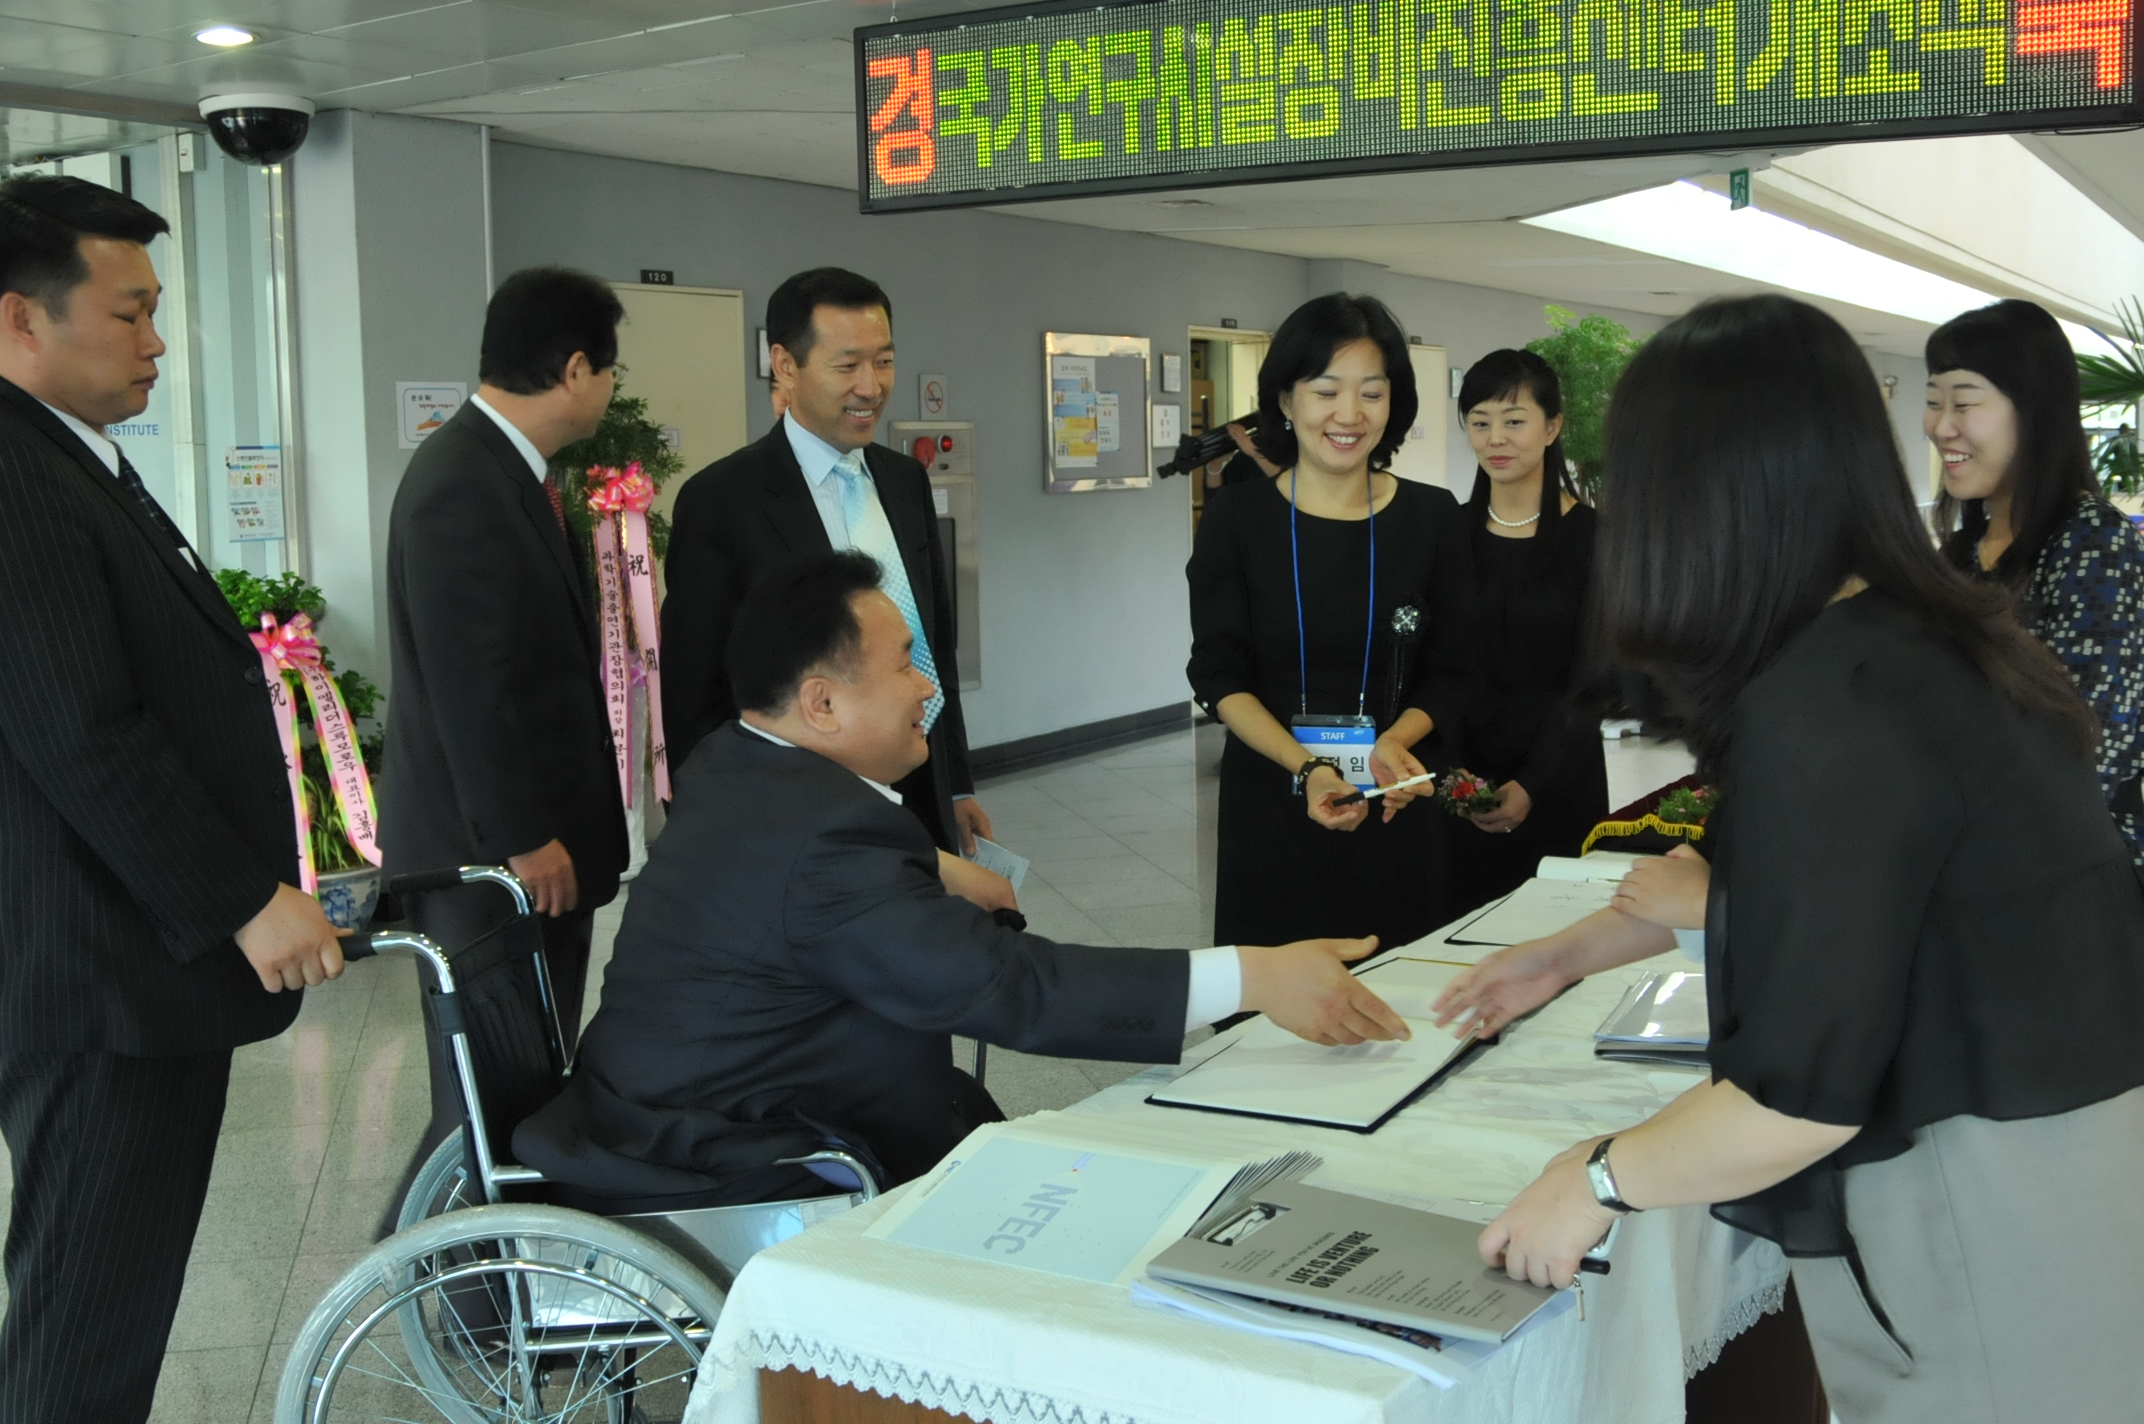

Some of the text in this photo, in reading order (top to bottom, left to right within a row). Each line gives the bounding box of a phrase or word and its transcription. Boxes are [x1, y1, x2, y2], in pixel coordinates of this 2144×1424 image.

[868, 48, 936, 186] 경
[648, 272, 667, 282] 120
[105, 424, 159, 436] NSTITUTE
[1320, 731, 1346, 741] STAFF
[983, 1183, 1078, 1255] NFEC
[1285, 1230, 1373, 1284] LIFE IS VENTURE
[1309, 1275, 1338, 1288] OR
[1324, 1245, 1380, 1277] NOTHING
